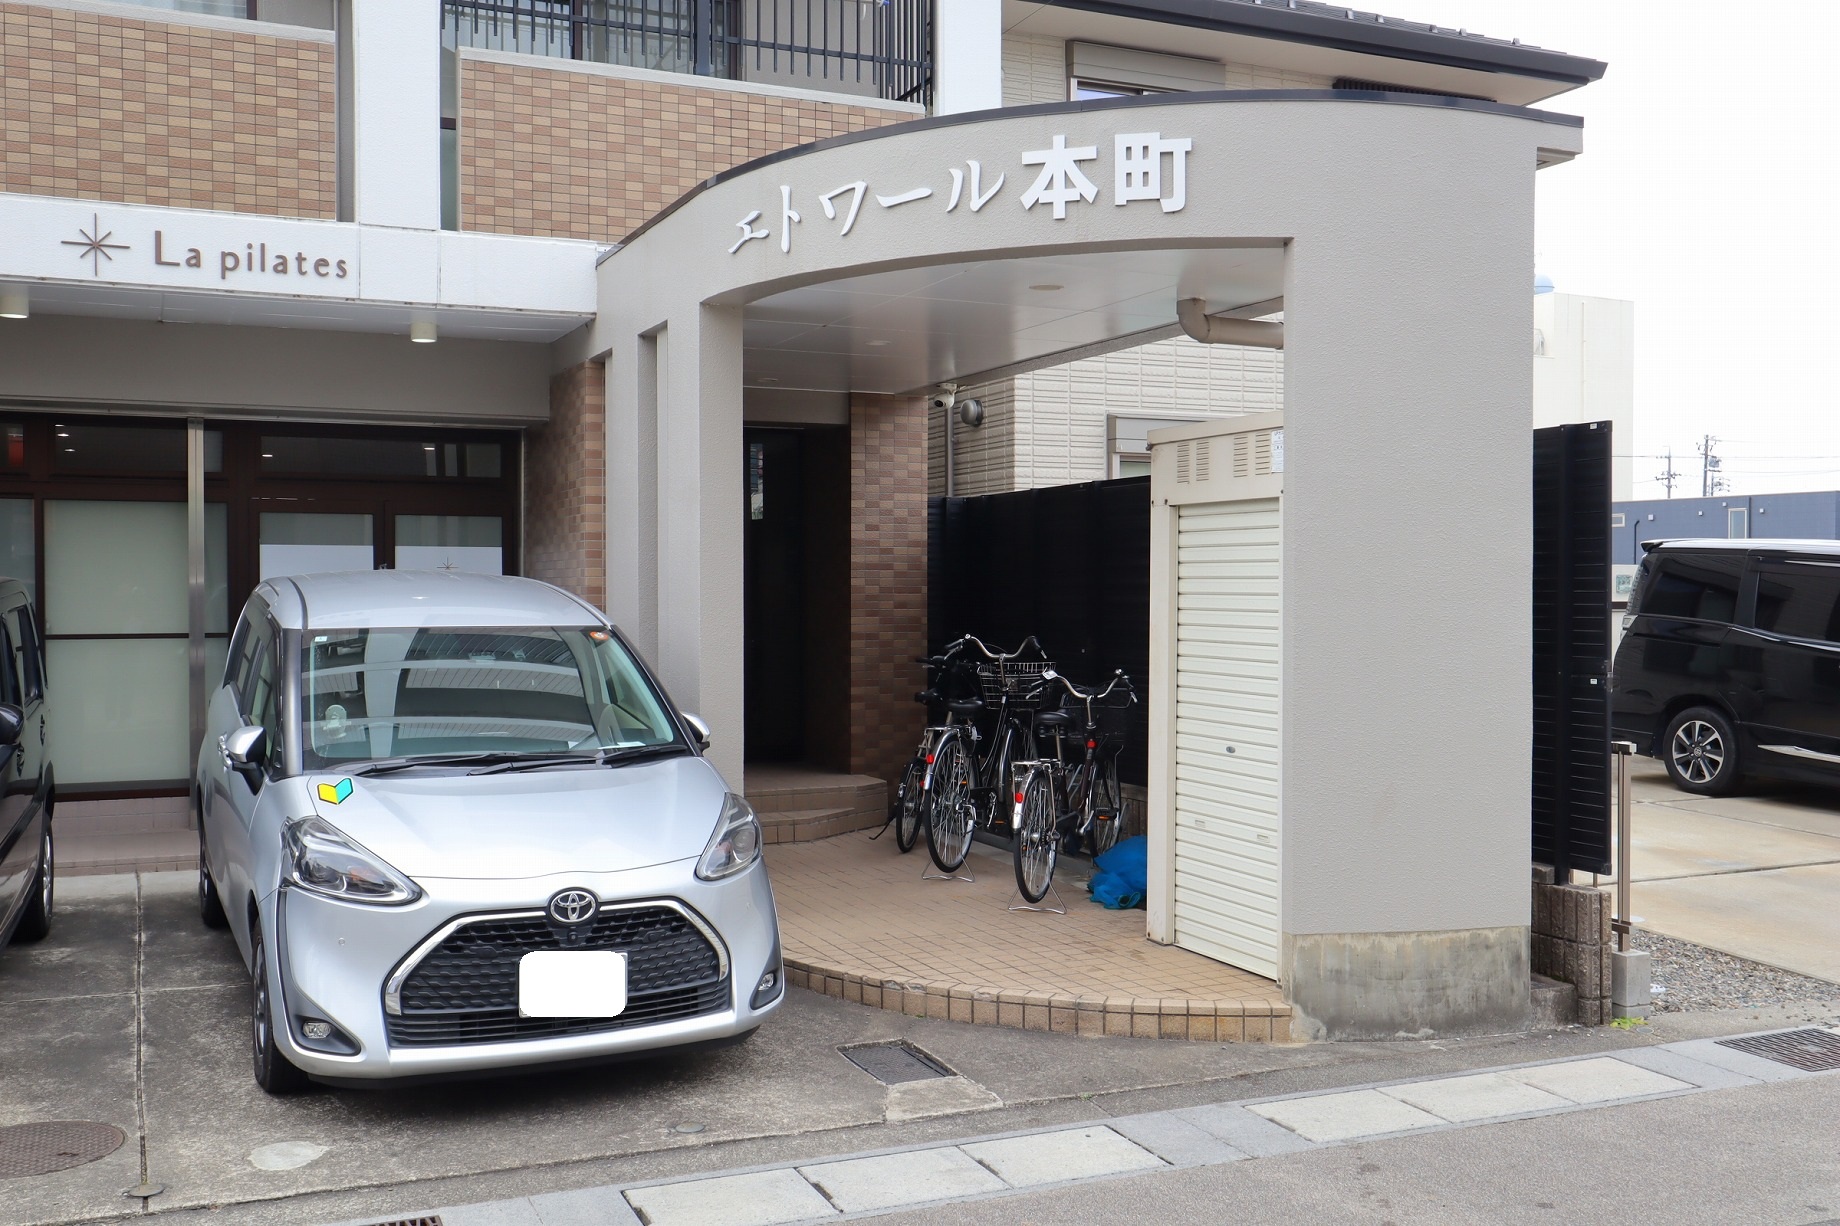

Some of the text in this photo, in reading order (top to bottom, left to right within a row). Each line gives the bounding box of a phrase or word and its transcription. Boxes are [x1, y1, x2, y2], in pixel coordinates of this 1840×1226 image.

[727, 132, 1192, 254] エトワール本町
[154, 230, 348, 280] La pilates
